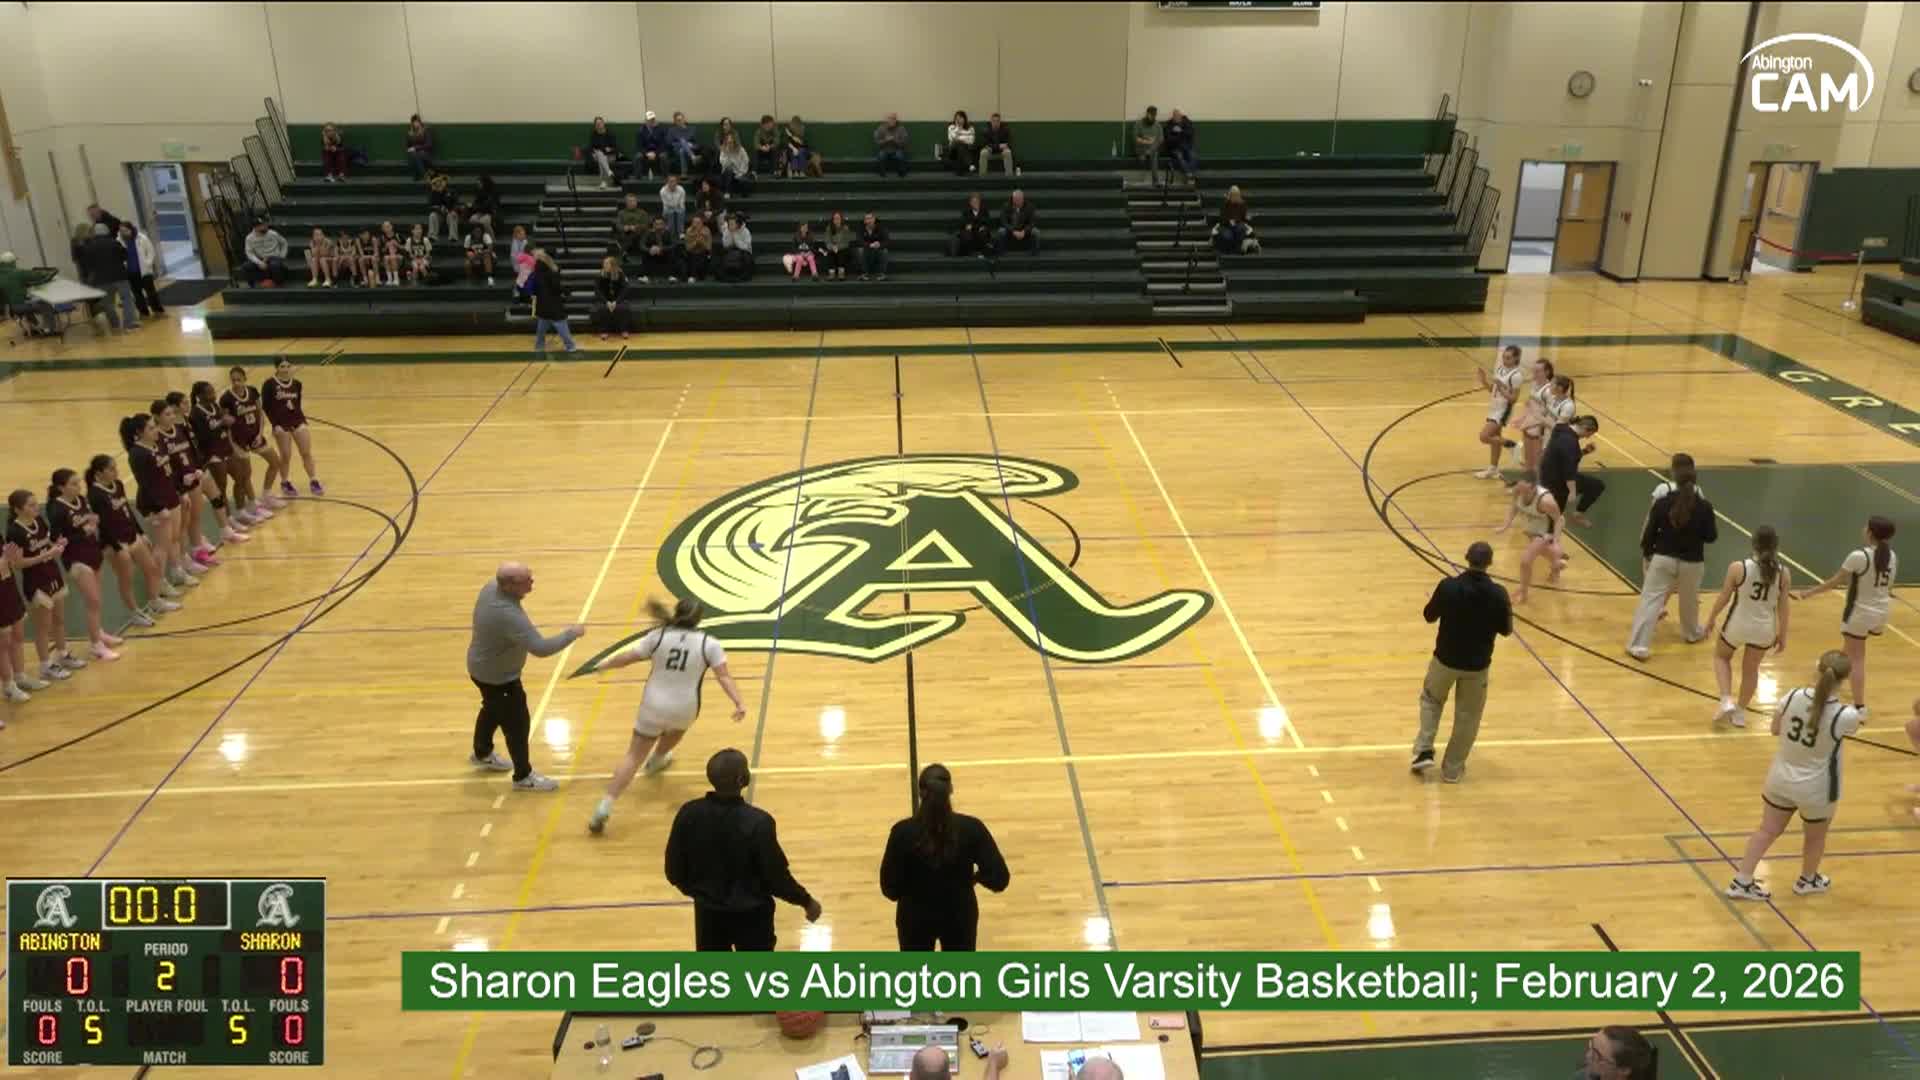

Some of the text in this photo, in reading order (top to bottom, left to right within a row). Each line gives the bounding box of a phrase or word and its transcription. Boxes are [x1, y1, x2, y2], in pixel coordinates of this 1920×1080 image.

[1873, 571, 1891, 588] 15
[1750, 582, 1770, 601] 31
[665, 647, 689, 672] 21
[1787, 717, 1819, 748] 33
